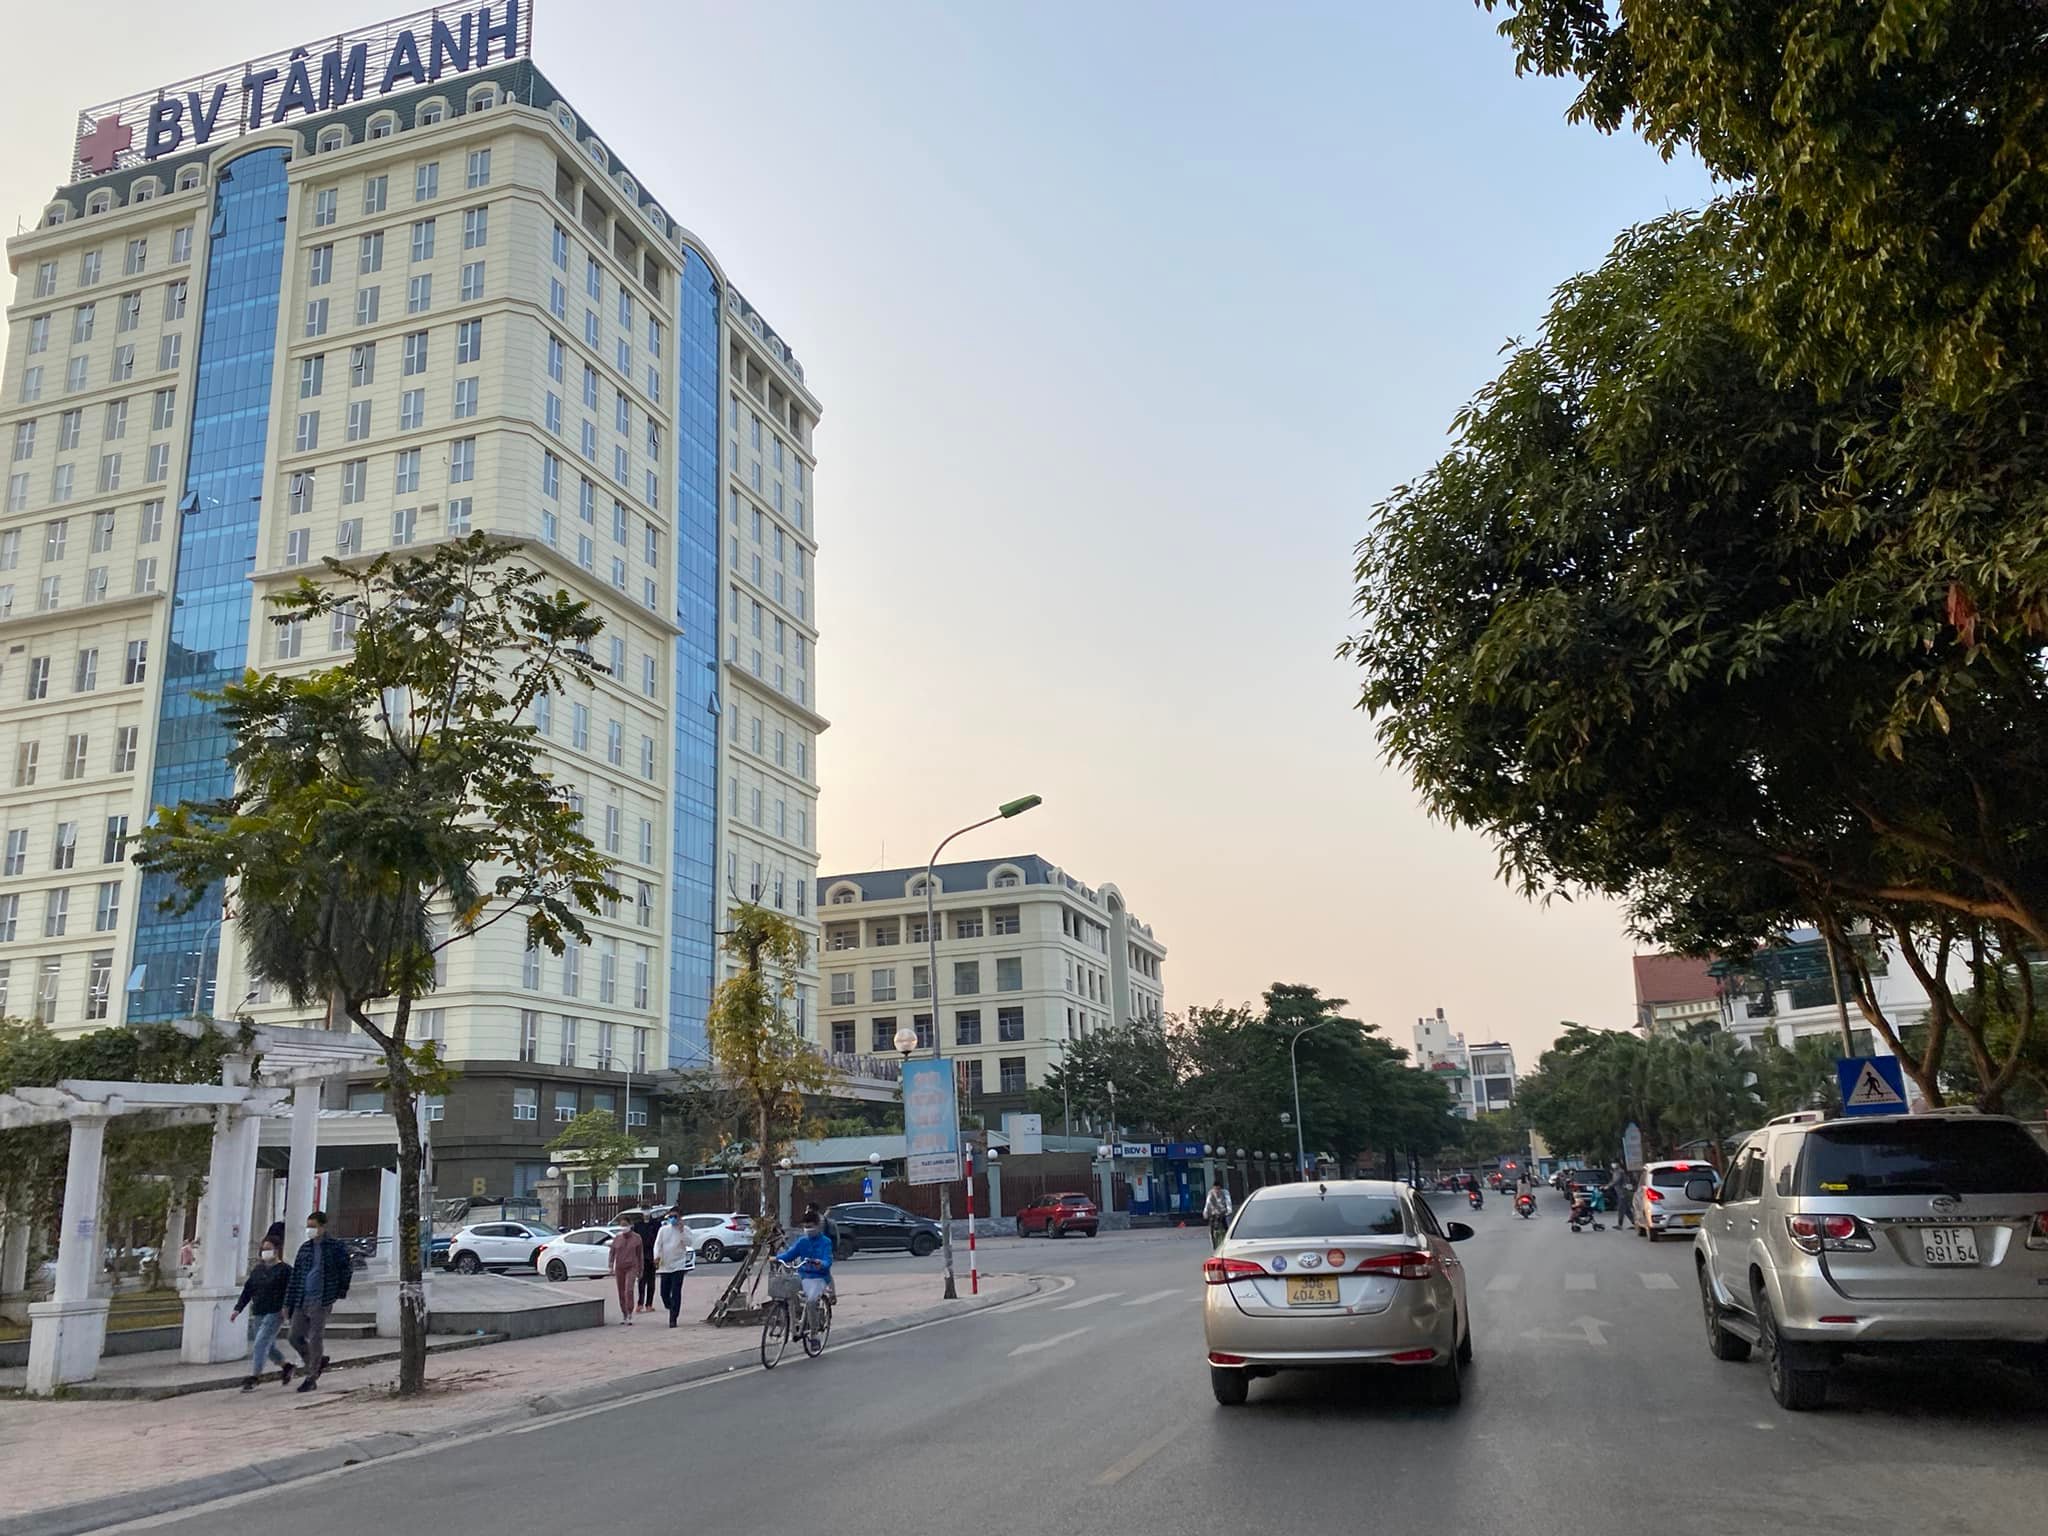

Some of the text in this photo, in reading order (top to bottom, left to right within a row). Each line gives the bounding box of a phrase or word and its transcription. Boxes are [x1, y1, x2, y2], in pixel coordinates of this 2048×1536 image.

[144, 0, 518, 158] BV TÂM ANH
[473, 1177, 486, 1197] B
[1932, 1229, 1960, 1245] 51F
